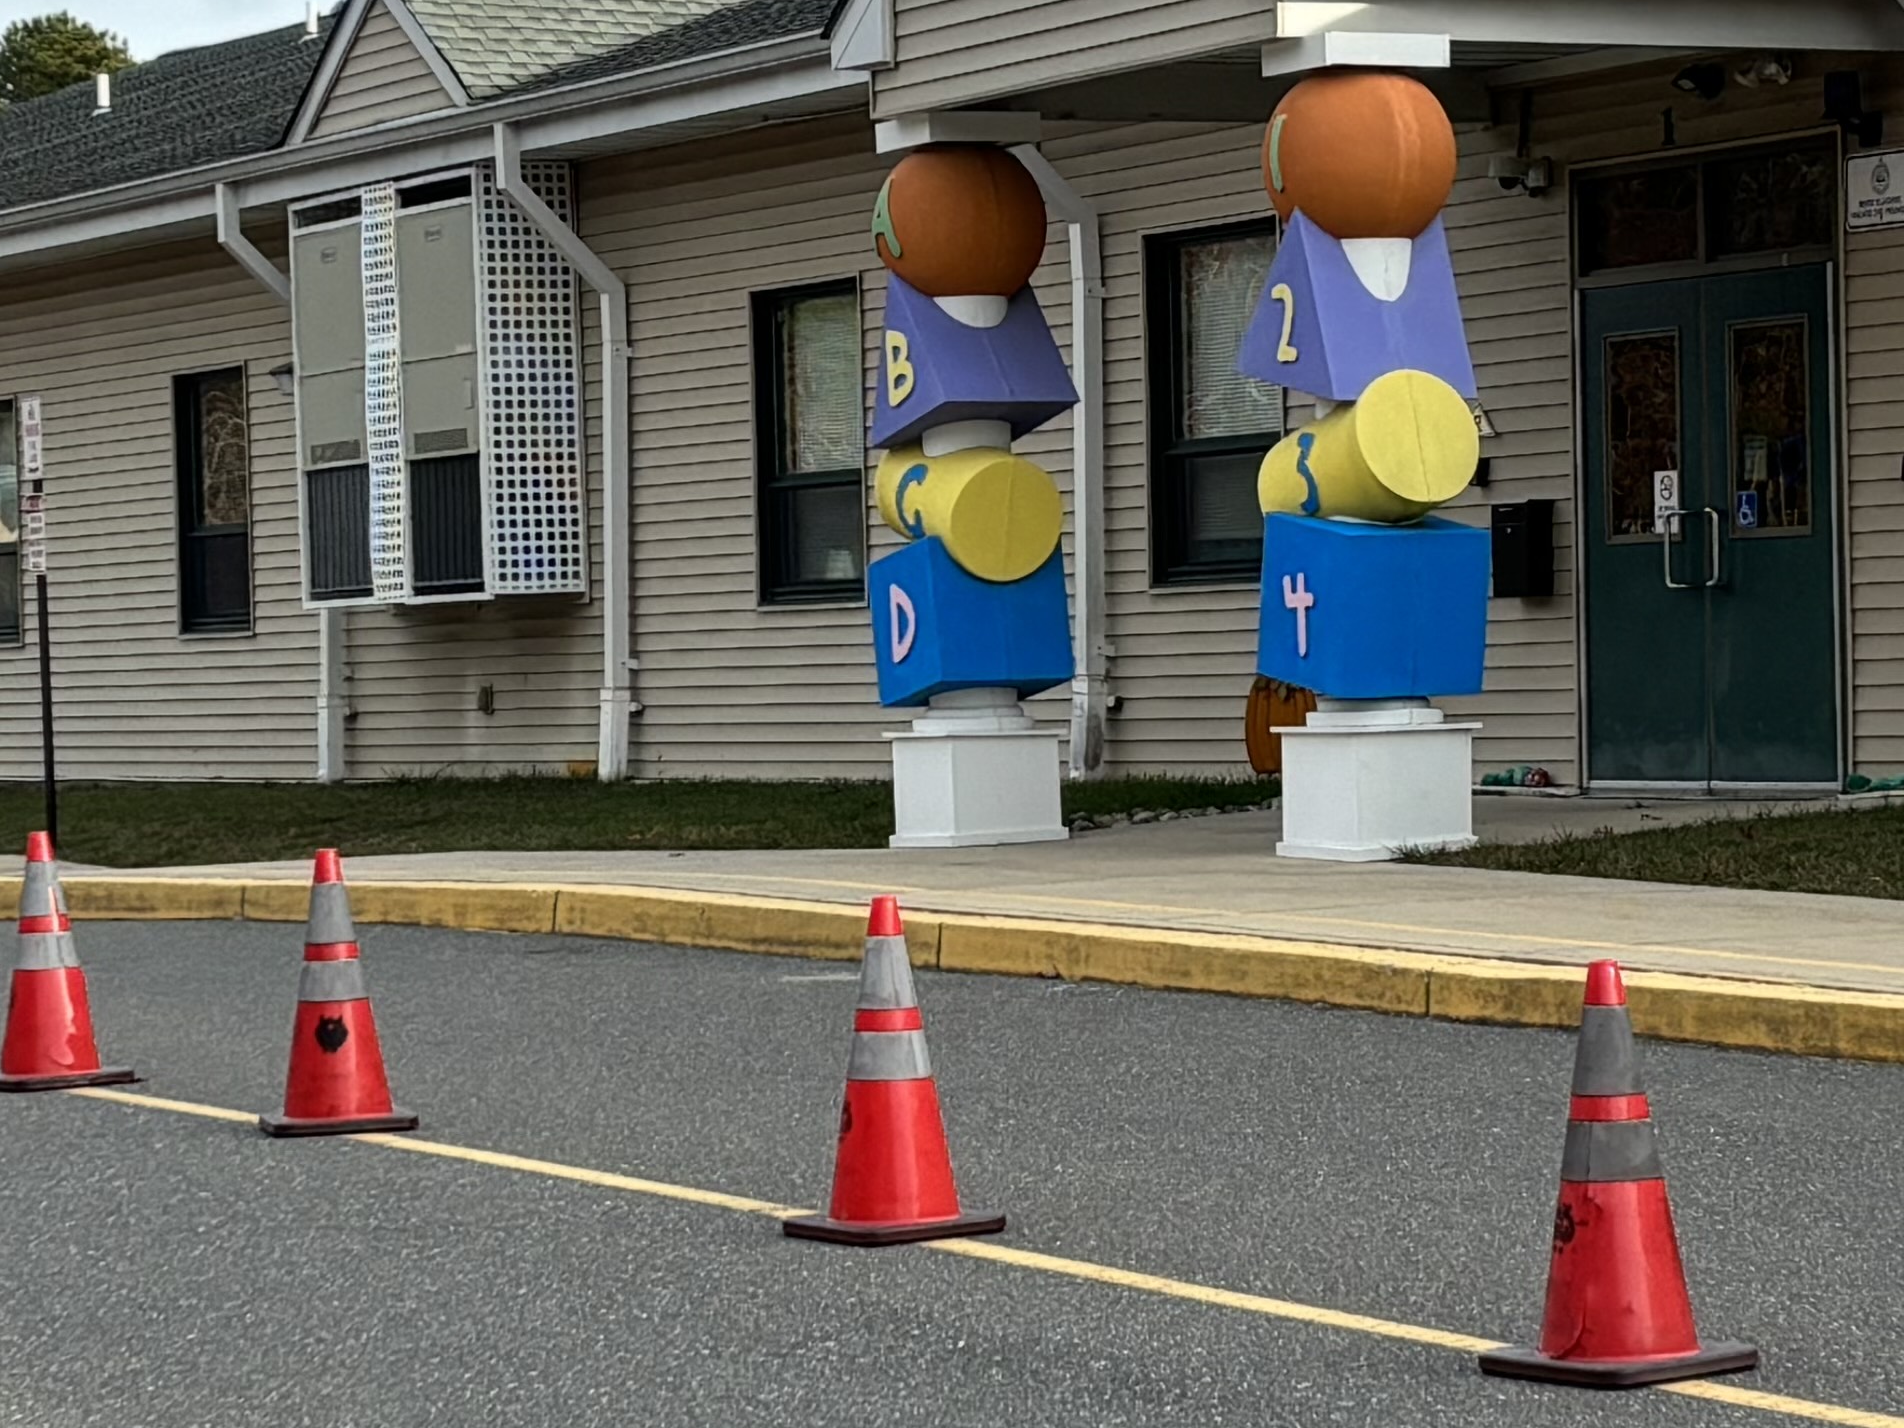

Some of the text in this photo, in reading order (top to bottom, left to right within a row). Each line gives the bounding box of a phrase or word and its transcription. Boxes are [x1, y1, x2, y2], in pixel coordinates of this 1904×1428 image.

[1662, 106, 1675, 146] 1
[871, 174, 903, 259] A
[1271, 283, 1298, 363] 2
[885, 329, 915, 408] B
[895, 463, 929, 539] C
[889, 583, 916, 664] D
[1282, 572, 1314, 658] 4
